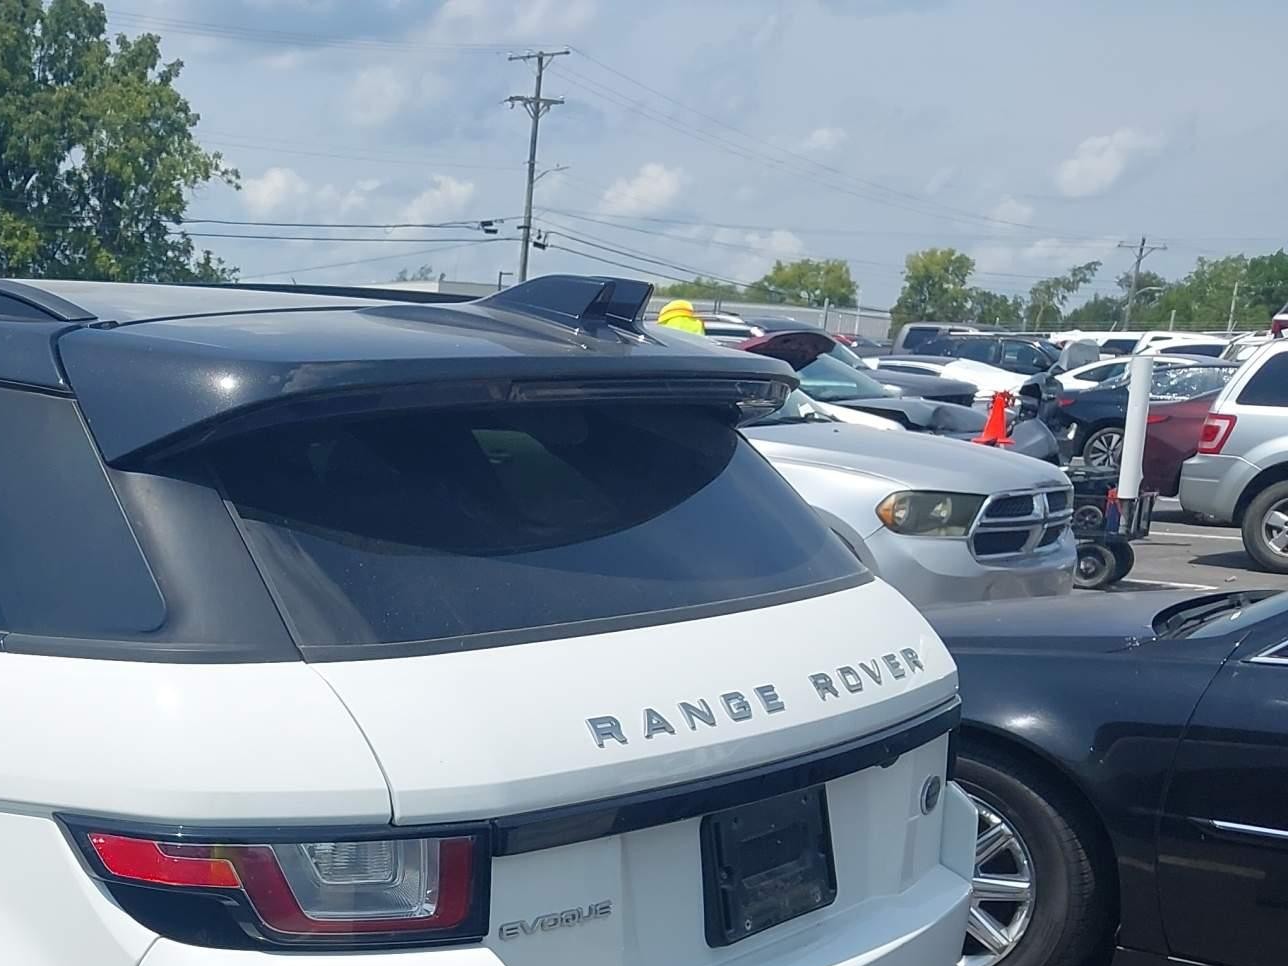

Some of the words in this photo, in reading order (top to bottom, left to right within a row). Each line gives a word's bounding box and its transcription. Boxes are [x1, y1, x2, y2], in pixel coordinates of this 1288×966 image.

[585, 684, 786, 749] RANGE
[808, 647, 925, 701] ROVER
[498, 899, 612, 941] EVOQUE
